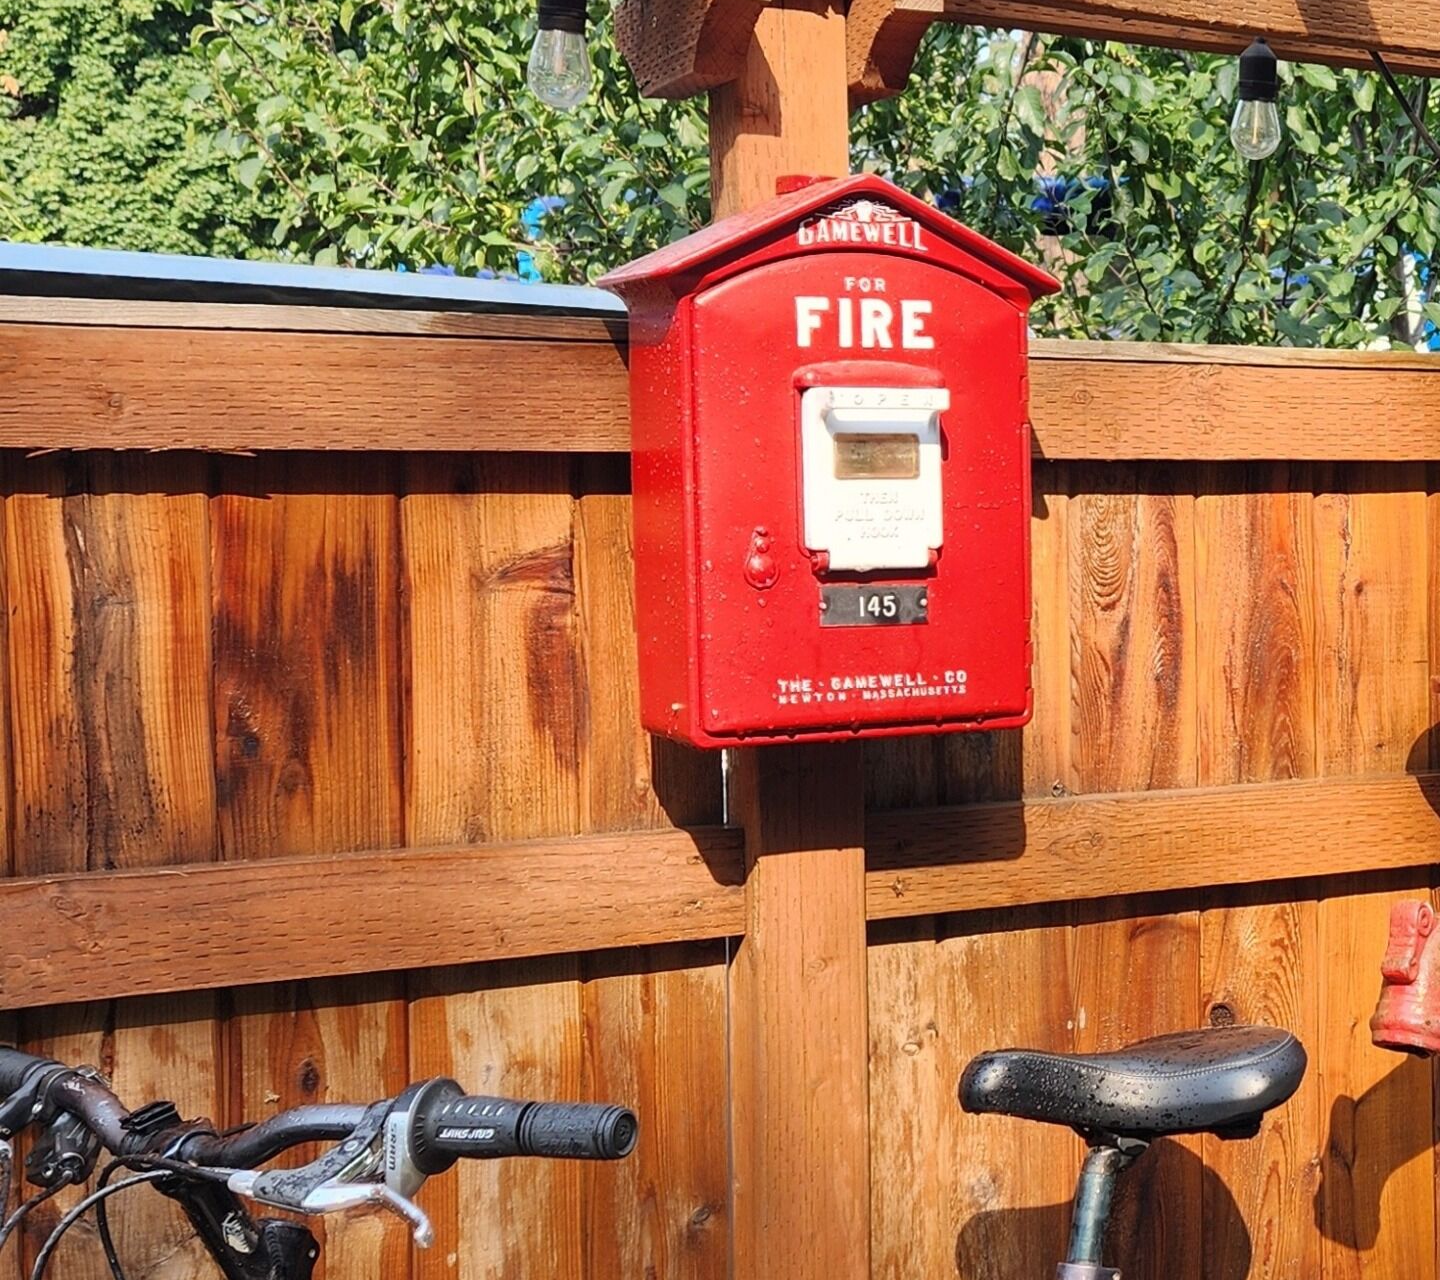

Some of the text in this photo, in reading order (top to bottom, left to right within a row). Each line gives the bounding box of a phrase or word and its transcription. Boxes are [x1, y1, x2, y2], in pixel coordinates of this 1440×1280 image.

[798, 218, 929, 252] GAMEWELL
[843, 276, 886, 293] FOR
[795, 296, 935, 349] FIRE
[858, 595, 897, 618] 145
[777, 669, 968, 693] THE GAMEWELL CO
[777, 684, 967, 705] NEWTON MASSACHUSETTS
